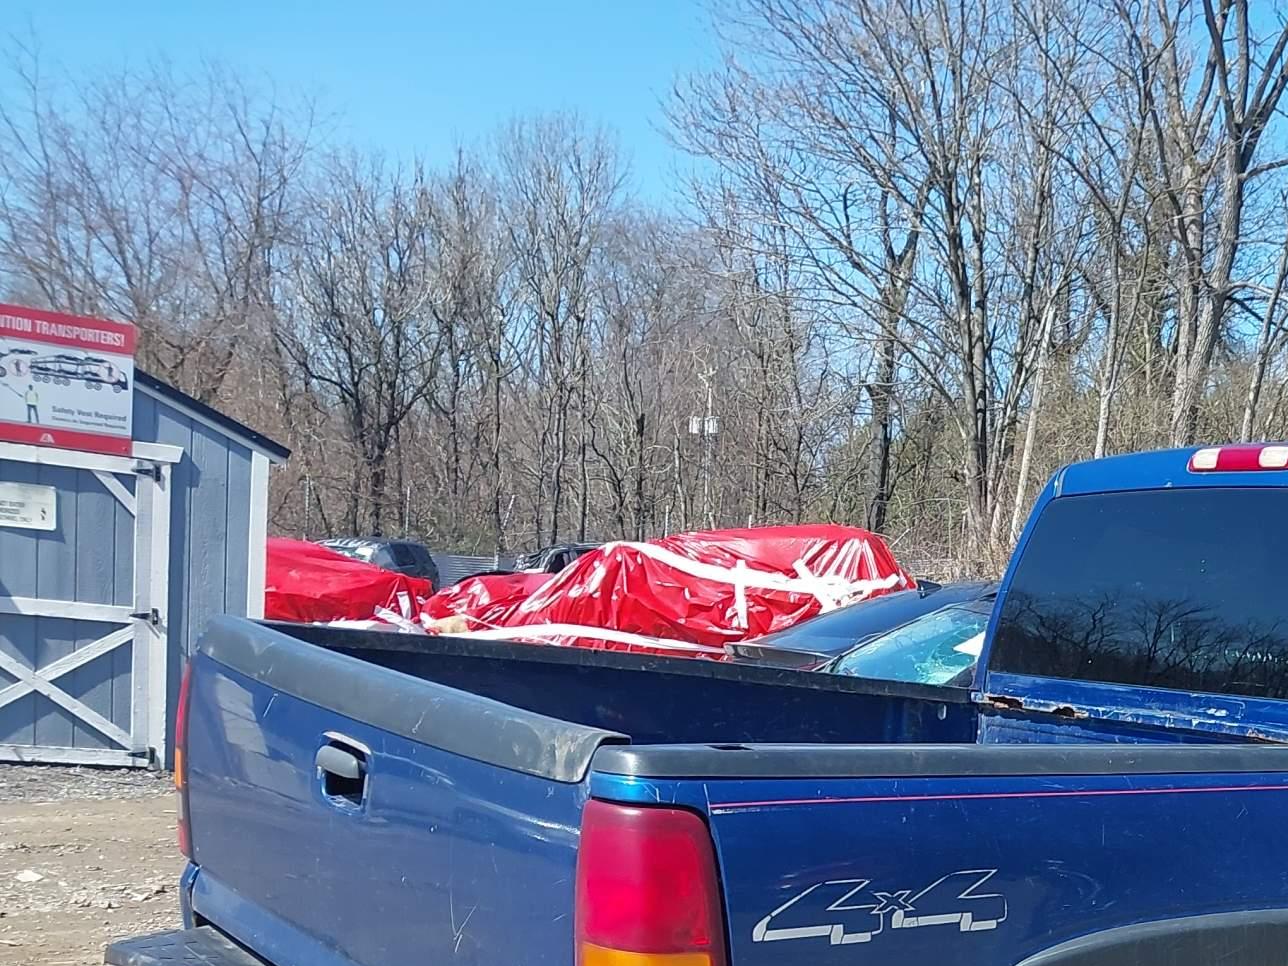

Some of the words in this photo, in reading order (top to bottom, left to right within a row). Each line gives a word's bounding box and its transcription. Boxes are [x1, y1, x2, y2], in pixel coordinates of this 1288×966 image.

[34, 320, 125, 347] TRANSPORTERS!
[52, 405, 75, 416] Safety
[77, 407, 92, 417] Vest
[94, 410, 127, 421] Required
[752, 868, 1008, 946] 4x4
